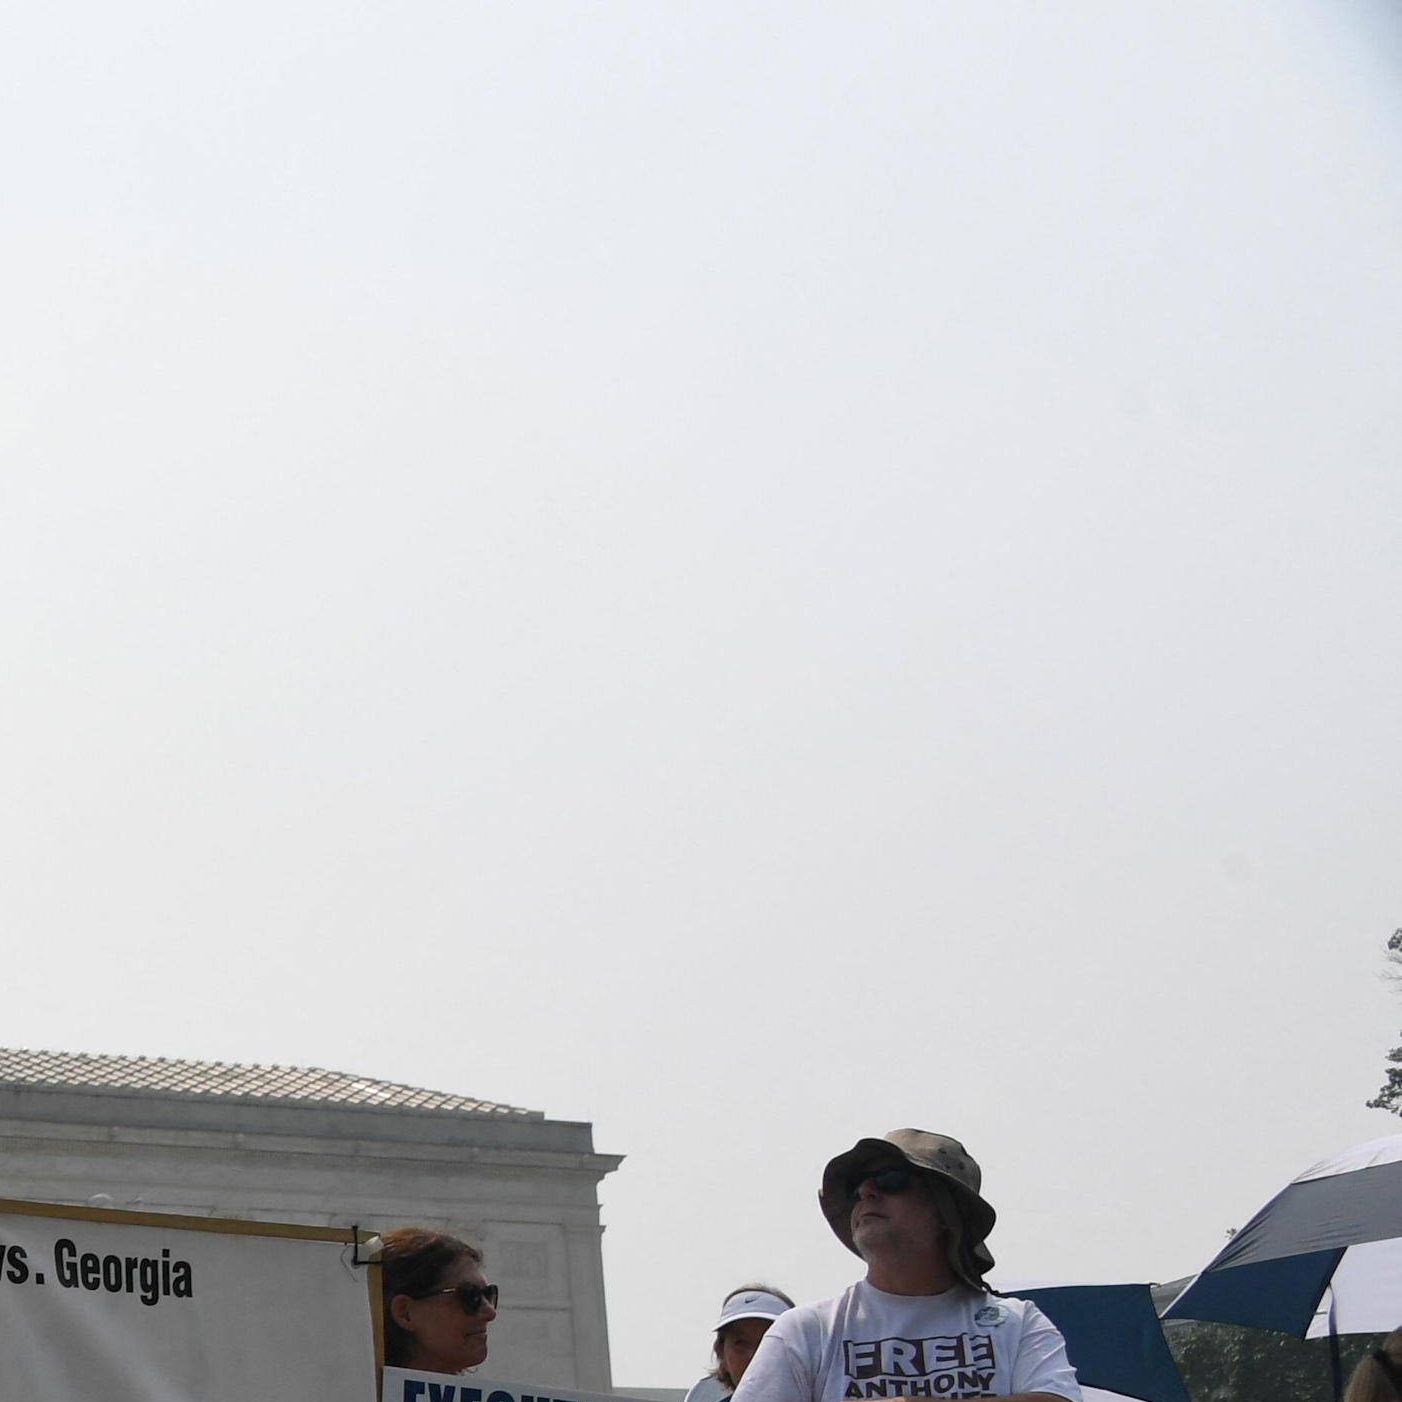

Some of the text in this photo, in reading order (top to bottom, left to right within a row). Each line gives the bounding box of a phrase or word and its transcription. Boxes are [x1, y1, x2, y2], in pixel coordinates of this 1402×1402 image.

[54, 1238, 193, 1307] Georgia
[846, 1332, 995, 1379] FREE
[844, 1369, 996, 1399] ANTHONY
